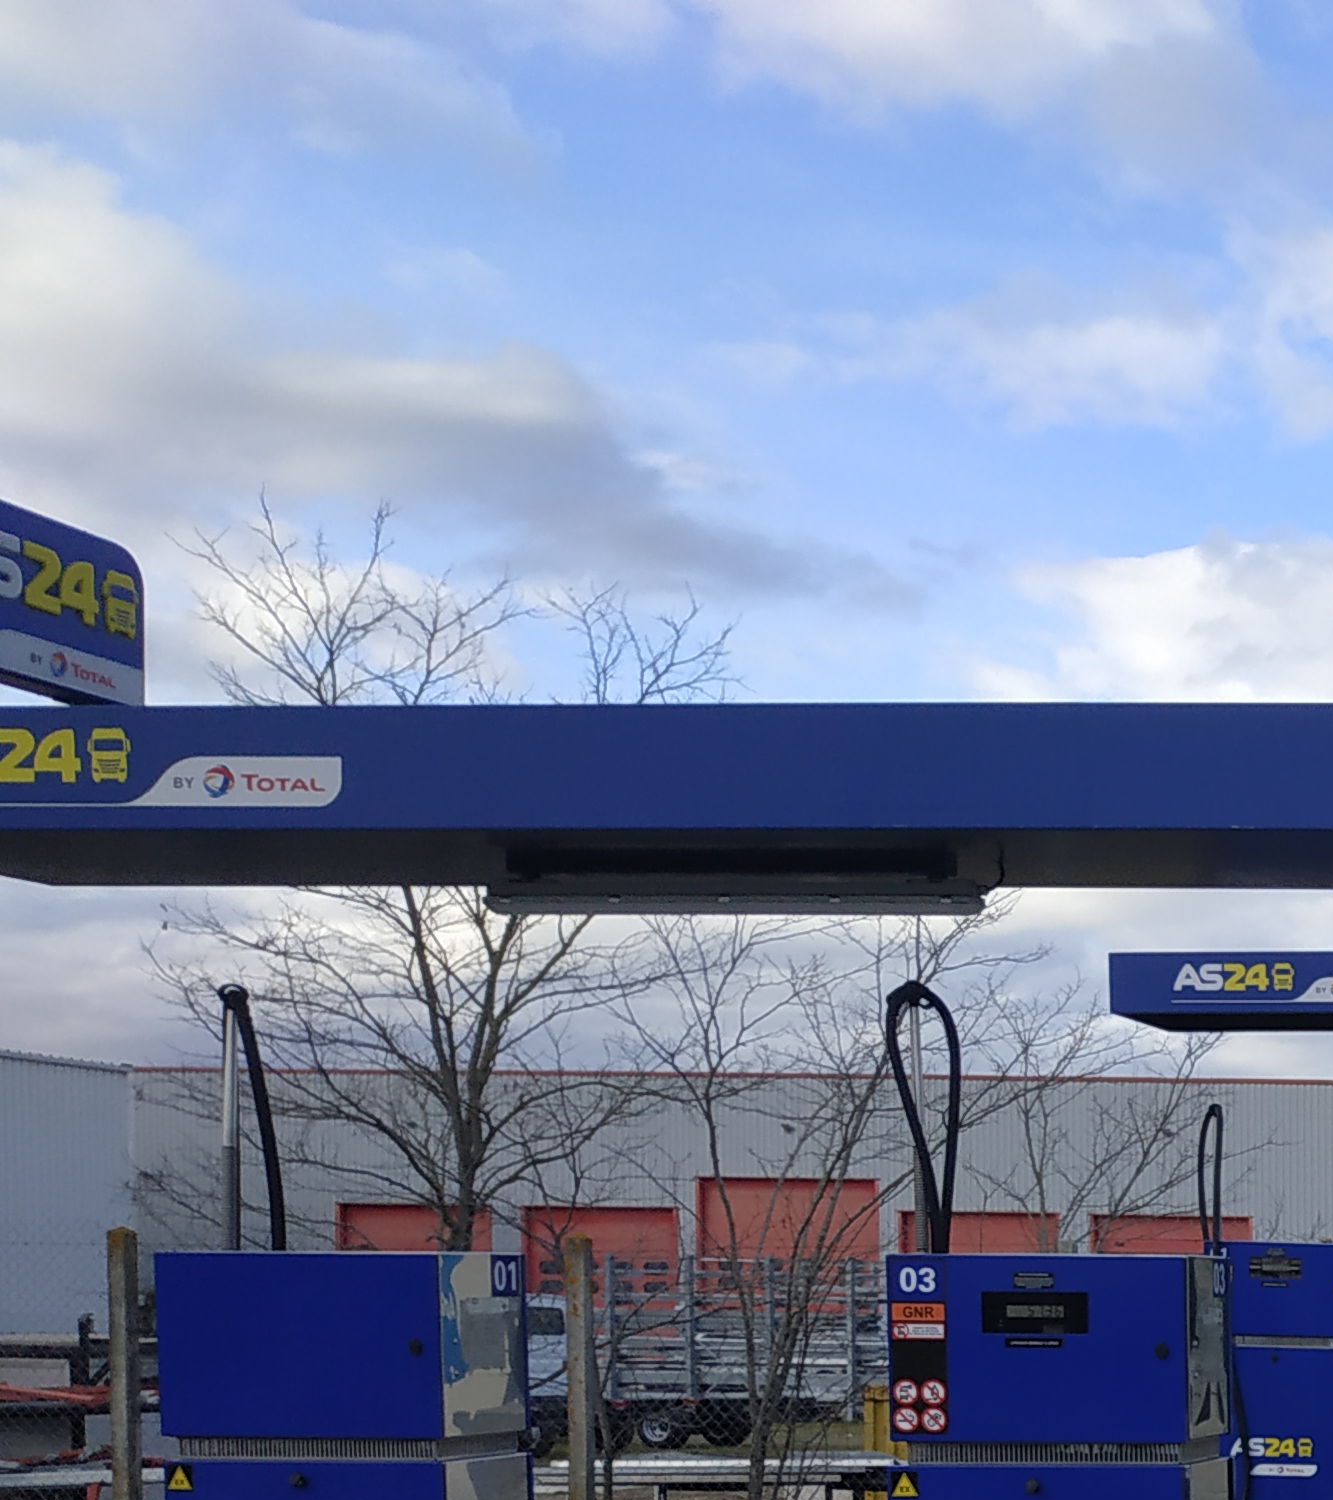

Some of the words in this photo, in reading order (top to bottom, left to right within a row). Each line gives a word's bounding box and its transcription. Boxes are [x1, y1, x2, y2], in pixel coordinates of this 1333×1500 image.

[30, 652, 43, 666] BY
[71, 662, 117, 690] TOTAL
[173, 776, 195, 789] BY
[241, 773, 326, 792] TOTAL
[1173, 963, 1270, 991] AS24
[1315, 986, 1327, 994] BY
[493, 1260, 517, 1292] 01
[899, 1266, 936, 1293] 03
[1213, 1261, 1226, 1295] 03
[902, 1305, 935, 1319] GNR
